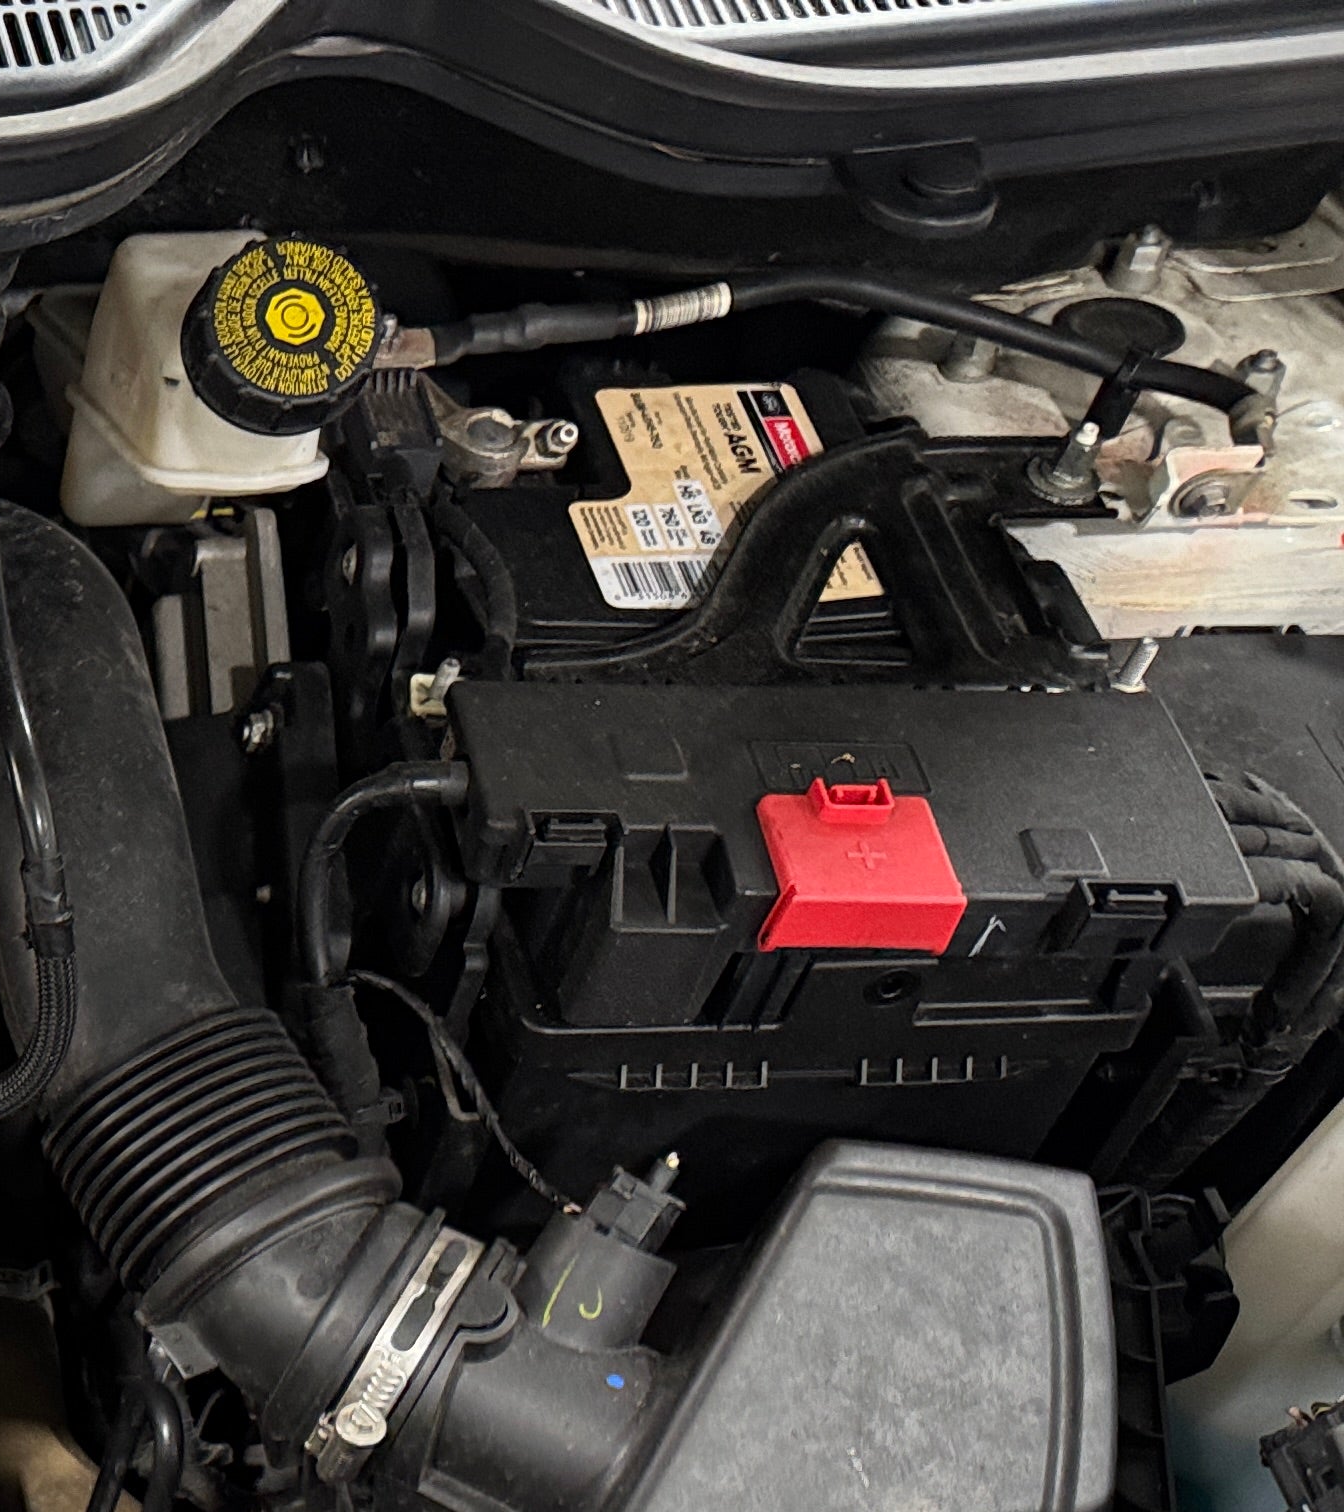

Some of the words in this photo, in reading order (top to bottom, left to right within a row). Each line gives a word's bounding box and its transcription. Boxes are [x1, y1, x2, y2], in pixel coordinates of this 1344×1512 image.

[275, 241, 334, 264] CONTAINER
[353, 327, 373, 357] FLUID
[258, 345, 321, 368] PROVENANT
[231, 354, 276, 391] NETTOYER
[333, 358, 357, 382] DOT
[276, 373, 331, 395] ATTENTION
[726, 434, 762, 474] AGM
